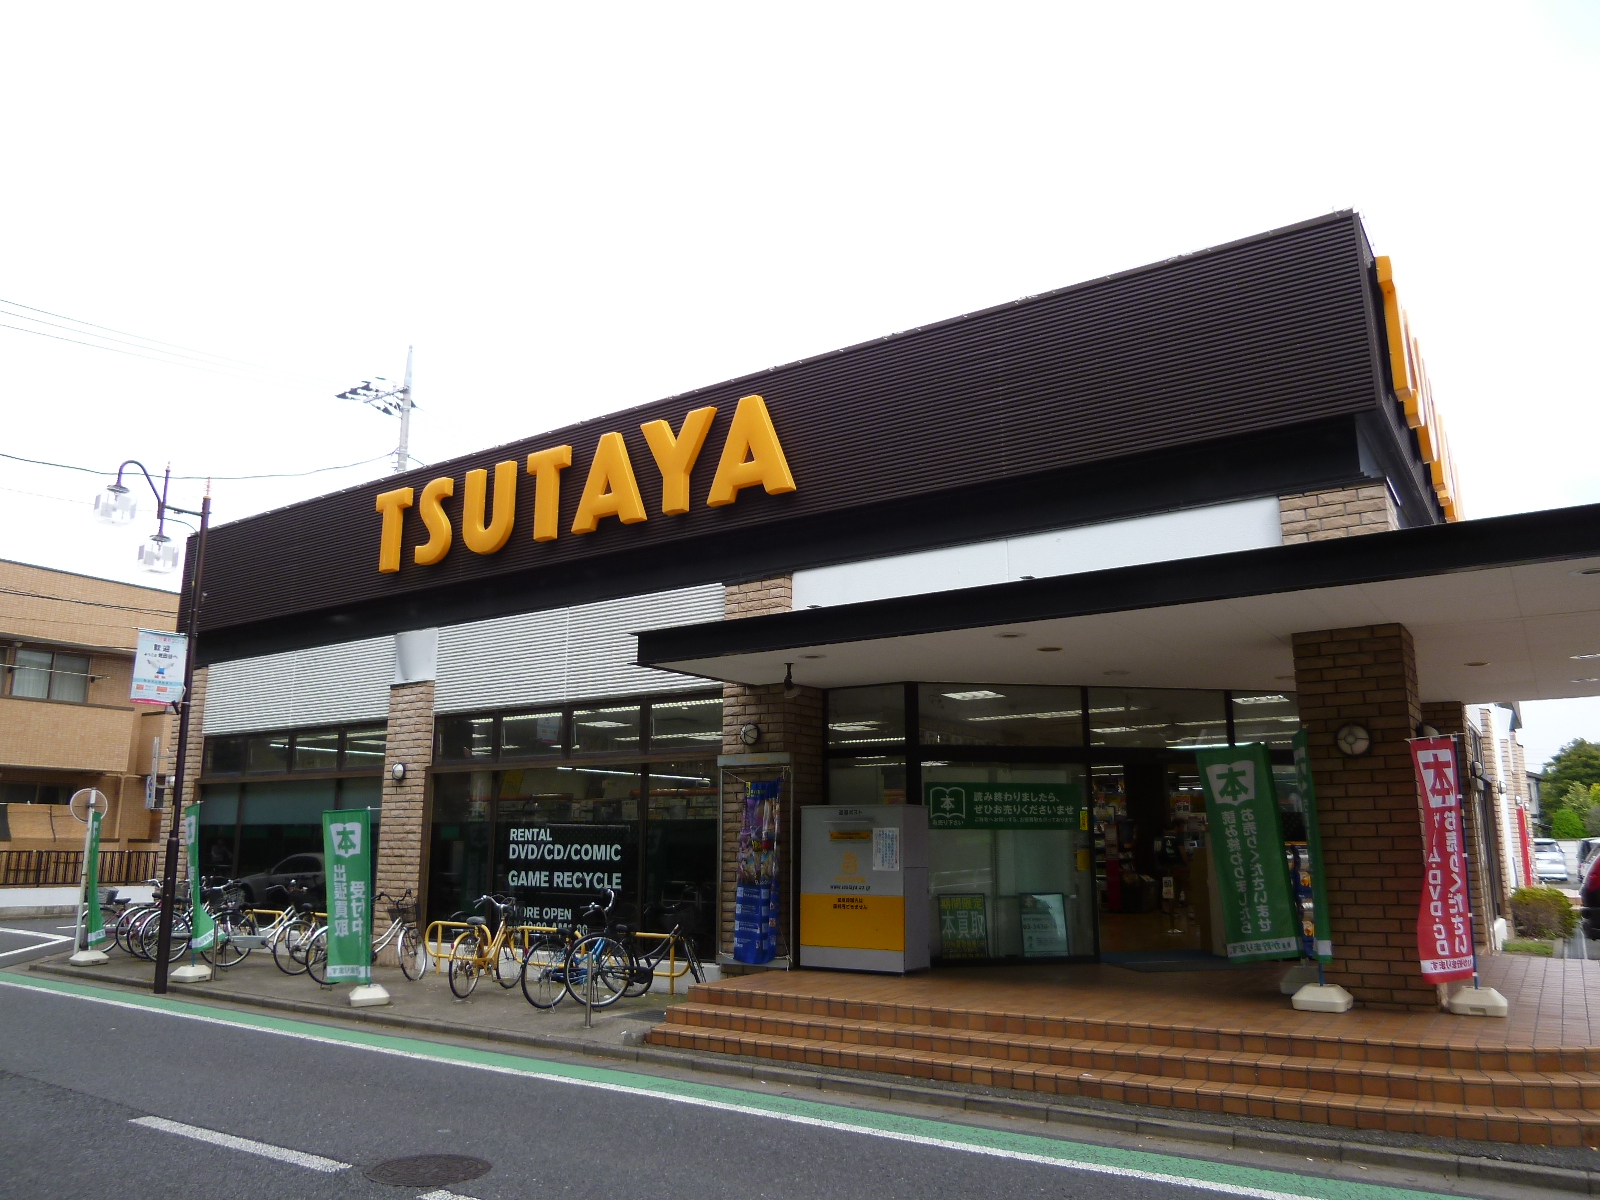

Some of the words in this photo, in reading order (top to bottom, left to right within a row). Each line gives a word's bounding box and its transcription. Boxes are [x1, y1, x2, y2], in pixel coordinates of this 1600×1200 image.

[375, 394, 796, 573] TSUTAYA
[154, 644, 170, 652] 歓迎
[940, 795, 955, 810] 本
[973, 791, 1060, 803] 読み終わりましたら、
[973, 804, 1075, 815] ぜひお売りくださいませ
[509, 828, 552, 841] RENTAL
[508, 843, 622, 861] DVD/CD/COMIC
[508, 870, 549, 887] GAME
[553, 872, 622, 889] RECYCLE
[941, 897, 983, 910] 期間限定
[542, 907, 572, 920] OPEN
[942, 910, 986, 939] 本買取
